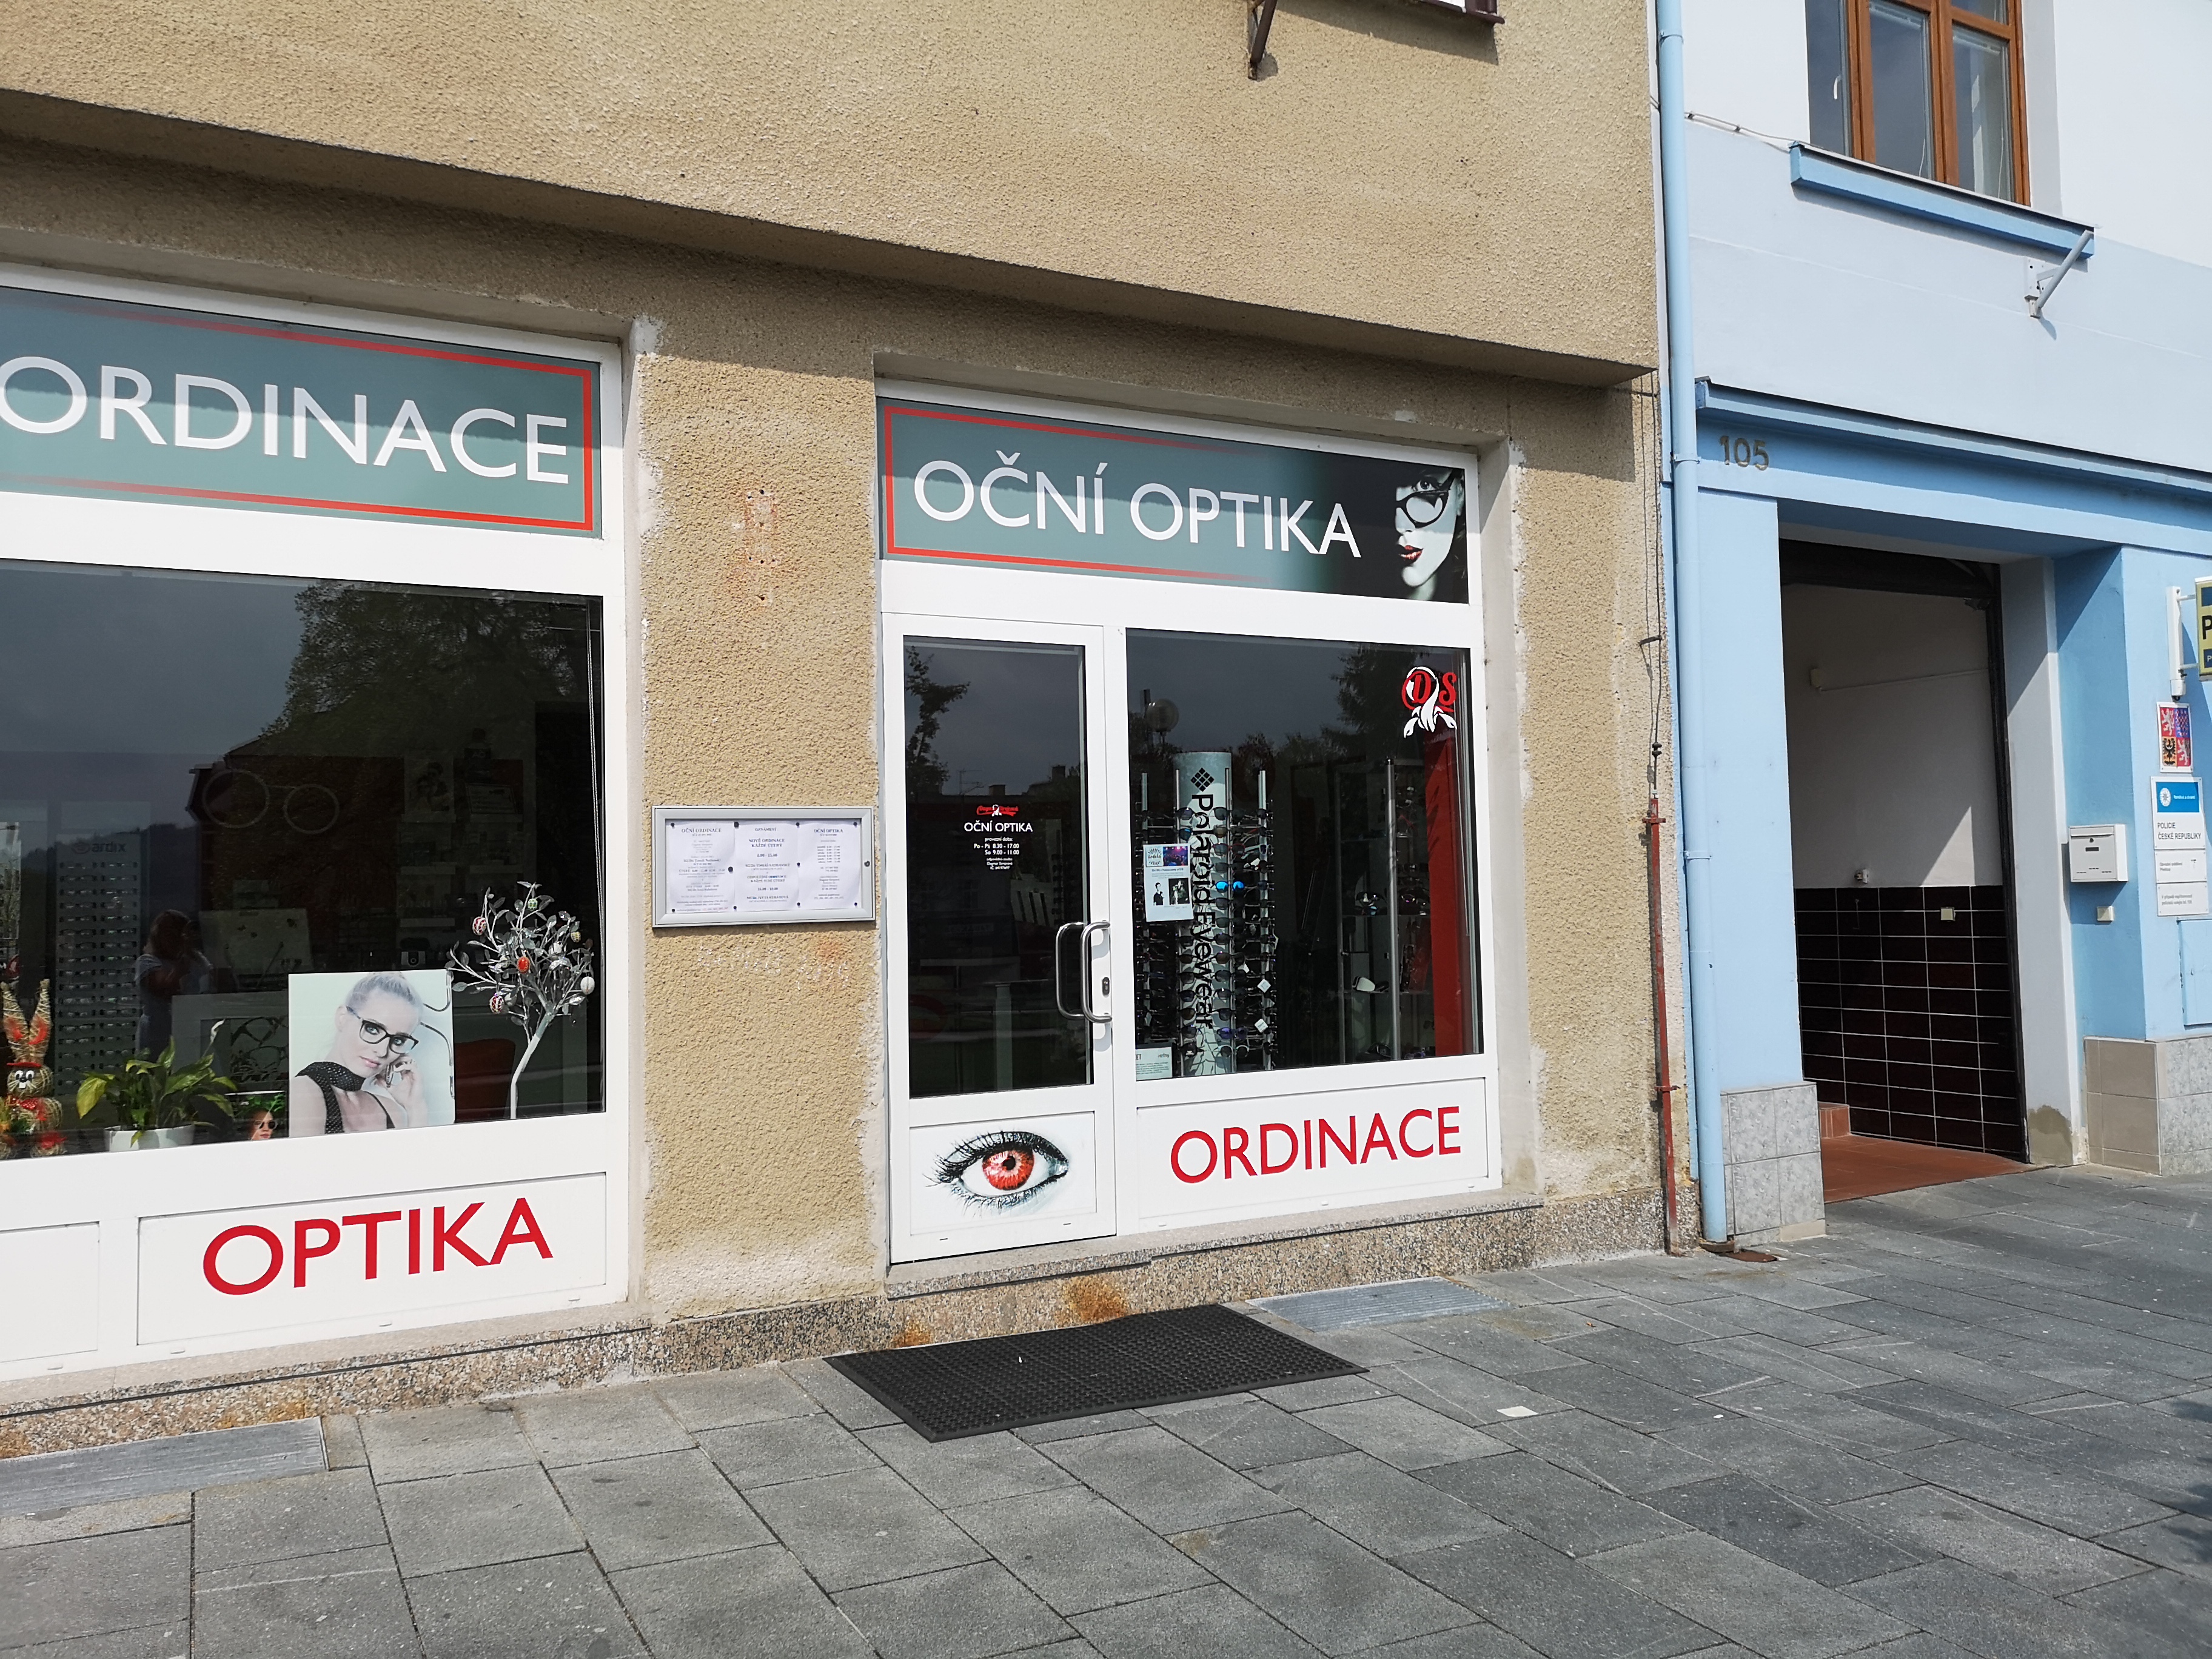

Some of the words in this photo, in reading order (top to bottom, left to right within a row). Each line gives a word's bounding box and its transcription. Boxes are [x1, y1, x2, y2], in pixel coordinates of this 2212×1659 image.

[0, 356, 569, 484] ORDINACE
[1720, 435, 1769, 471] 105
[914, 449, 1109, 535] OČNÍ
[1129, 482, 1362, 558] OPTIKA
[964, 820, 993, 832] OČNÍ
[995, 822, 1033, 833] OPTIKA
[1191, 794, 1215, 904] Polaroid
[1190, 912, 1216, 1029] Eyewear
[1170, 1105, 1462, 1184] ORDINACE
[203, 1197, 554, 1295] OPTIKA
